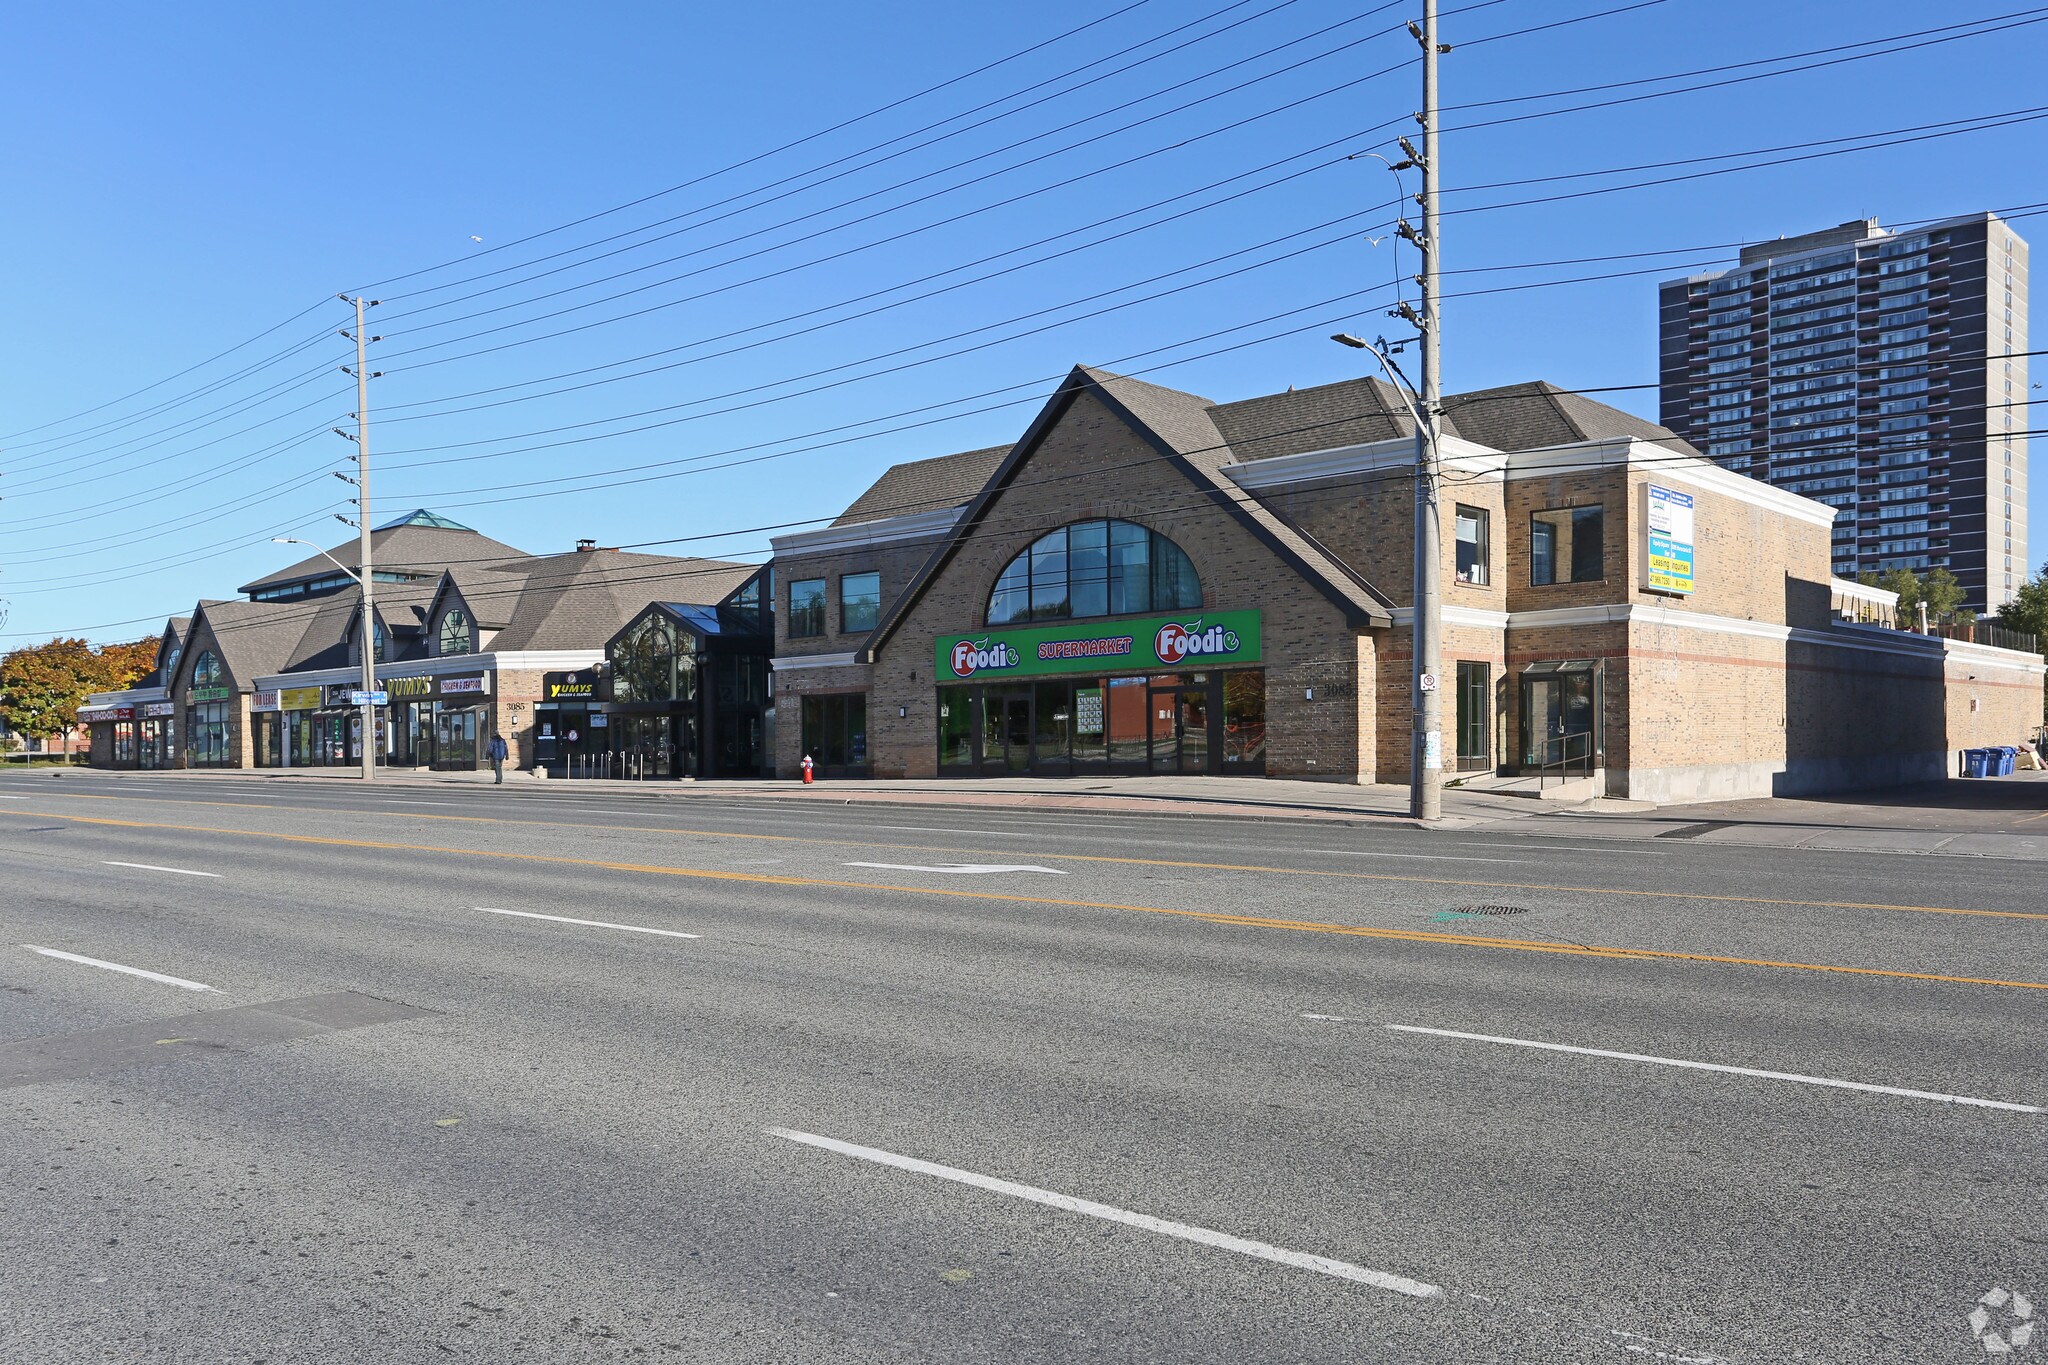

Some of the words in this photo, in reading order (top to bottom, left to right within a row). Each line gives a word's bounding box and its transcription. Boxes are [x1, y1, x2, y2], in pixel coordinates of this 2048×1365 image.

[1653, 557, 1670, 571] Leasing
[1160, 624, 1240, 655] Foodie
[1037, 636, 1133, 660] SUPERMARKET
[954, 642, 1020, 670] Foodie
[441, 680, 458, 691] CHICKEN
[463, 679, 481, 690] SEAFOOD
[253, 694, 262, 706] FOR
[262, 693, 277, 706] LEASE
[506, 702, 525, 711] 3085
